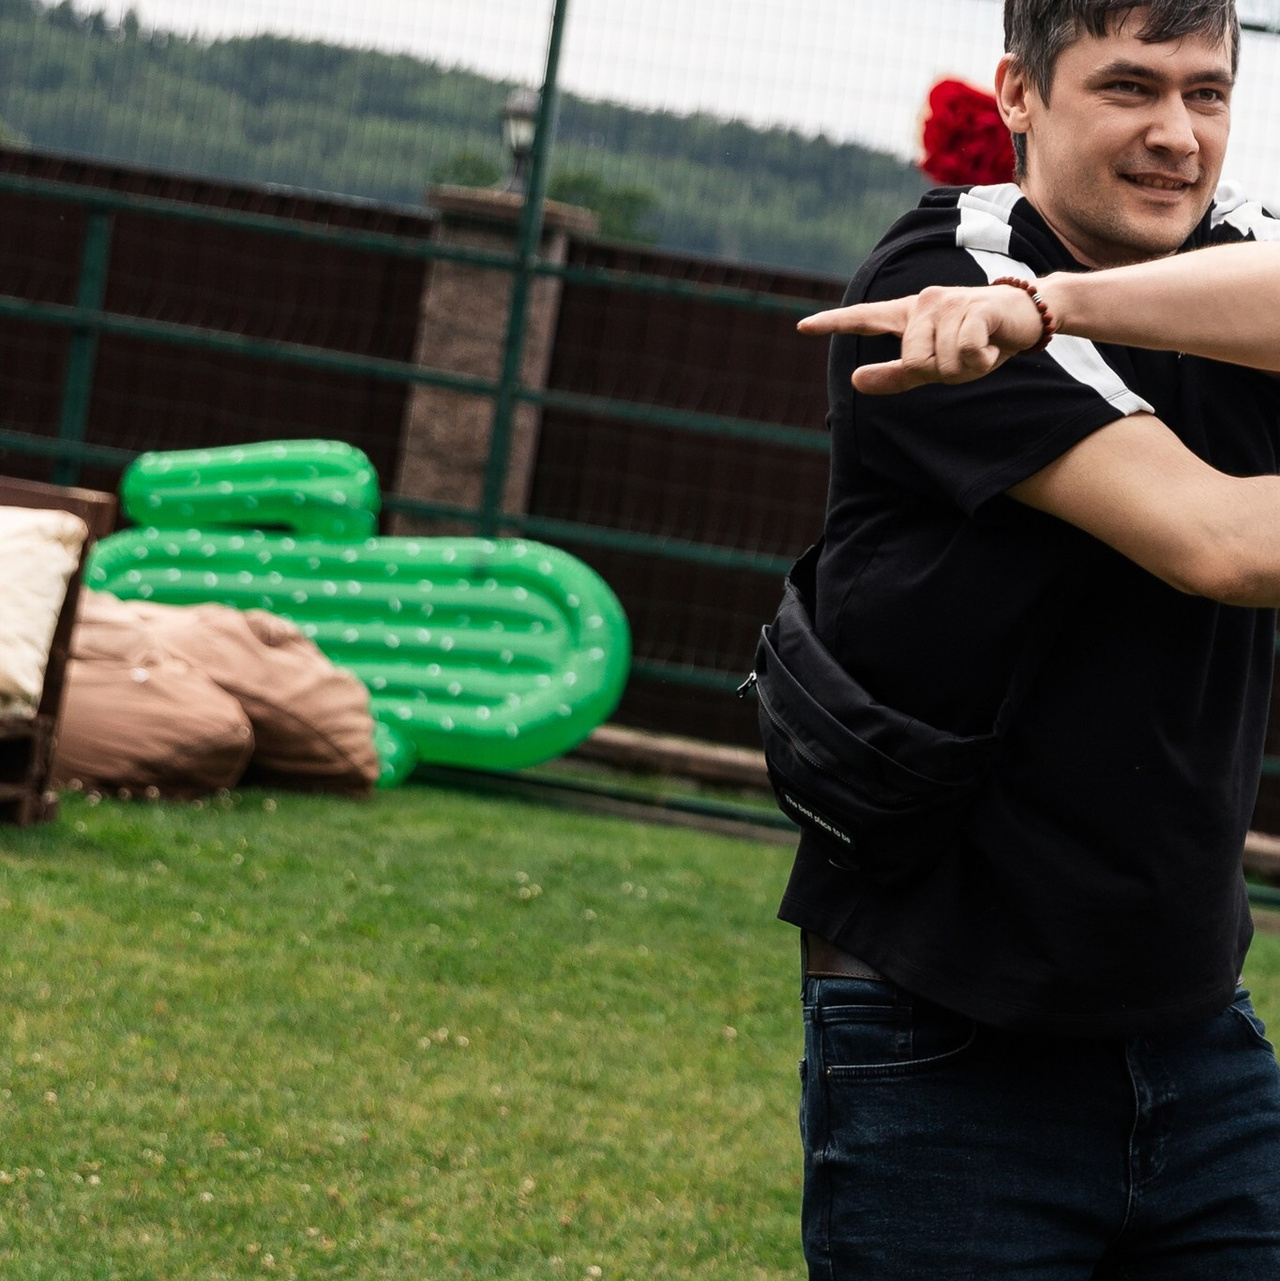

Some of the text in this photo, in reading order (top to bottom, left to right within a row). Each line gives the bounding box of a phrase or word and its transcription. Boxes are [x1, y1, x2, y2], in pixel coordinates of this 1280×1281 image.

[784, 794, 851, 844] The best place to be
